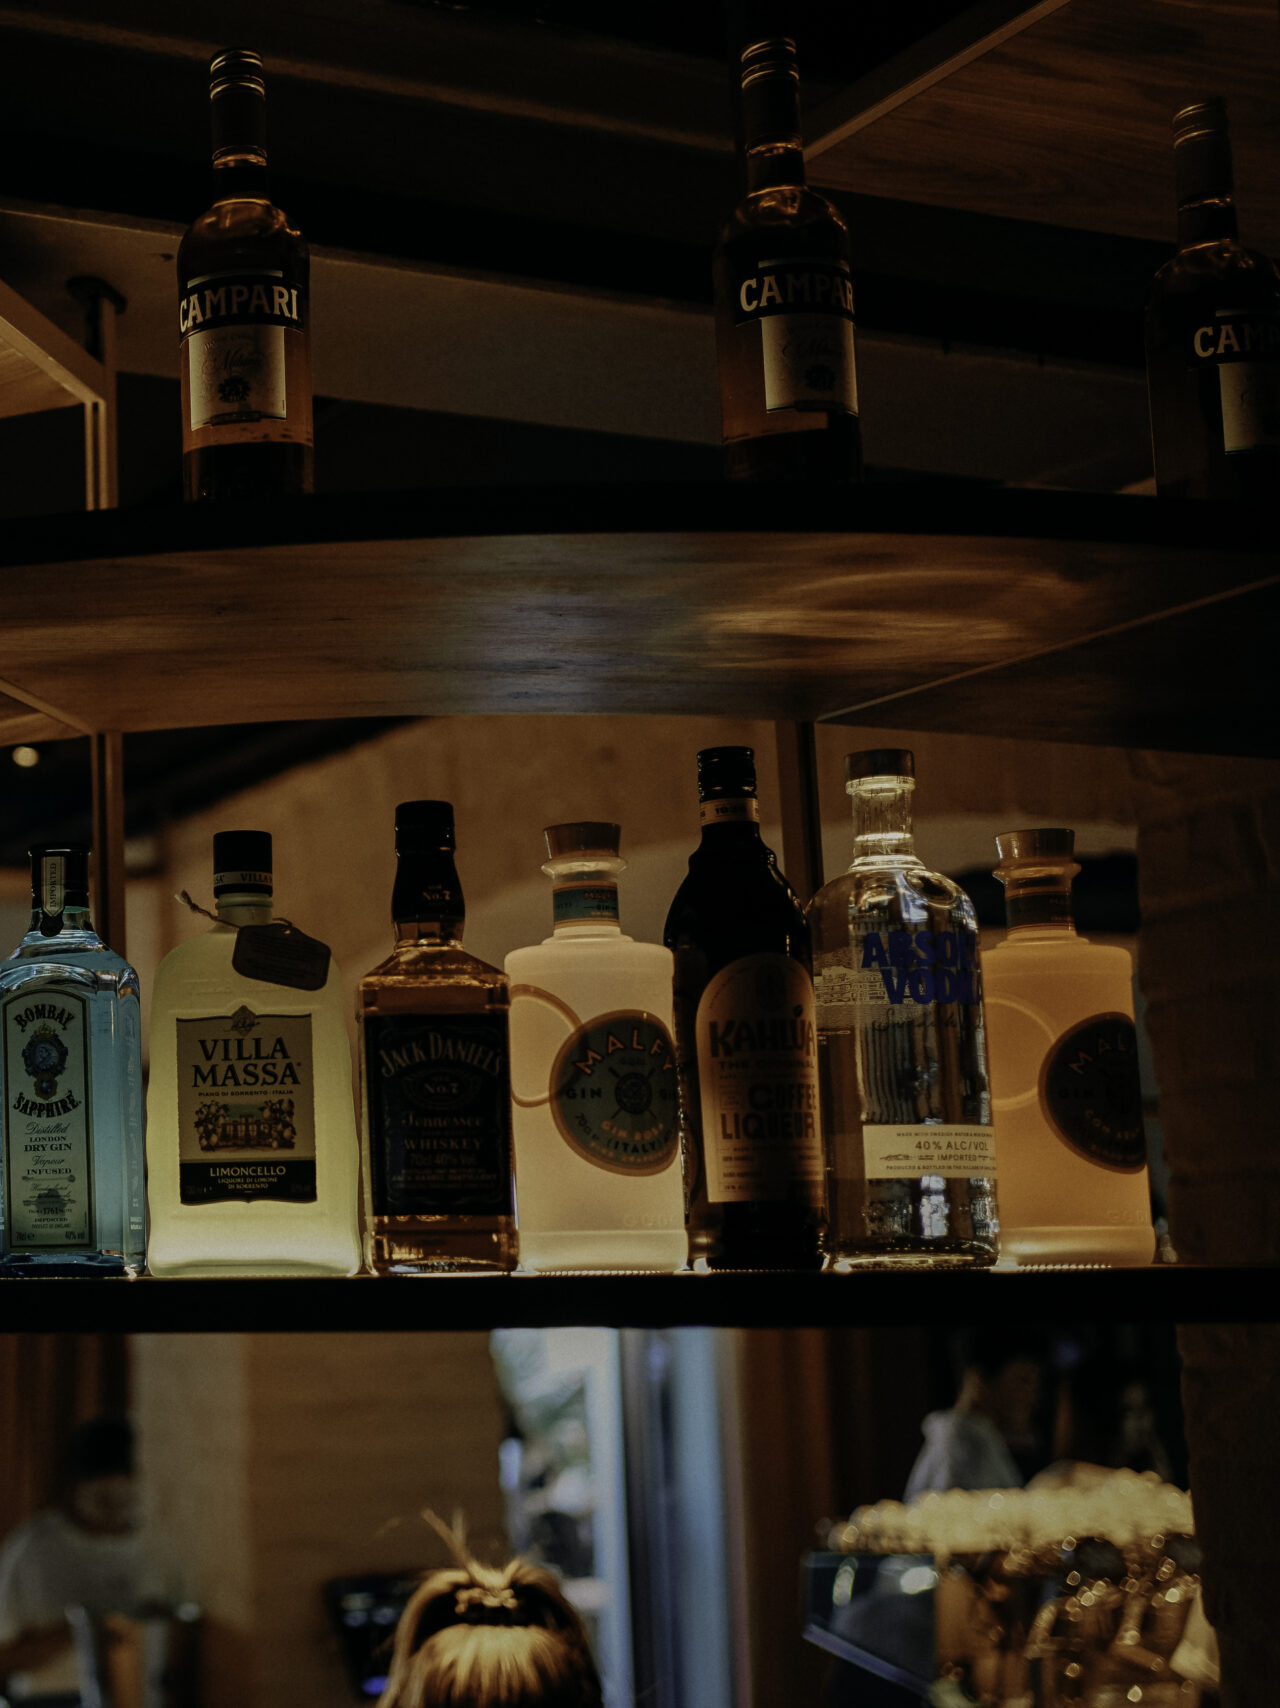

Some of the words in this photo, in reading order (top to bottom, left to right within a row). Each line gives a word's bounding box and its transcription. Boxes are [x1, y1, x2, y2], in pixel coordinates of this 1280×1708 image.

[180, 284, 298, 333] CAMPARI
[14, 1004, 74, 1033] BOMBAY
[198, 1037, 290, 1062] VILLA
[377, 1038, 427, 1079] JACK
[574, 1027, 673, 1076] MALFY
[192, 1062, 301, 1088] MASSA
[13, 1090, 79, 1118] SAPPHIRE
[566, 1088, 602, 1099] GIN
[24, 1121, 70, 1135] Distilled
[721, 1111, 816, 1140] LIQUEUR
[24, 1144, 48, 1152] DRY
[50, 1143, 73, 1151] GIN
[946, 1141, 989, 1151] ALC/VOL
[27, 1168, 72, 1176] INFUSED
[209, 1165, 287, 1177] LIMONCELLO
